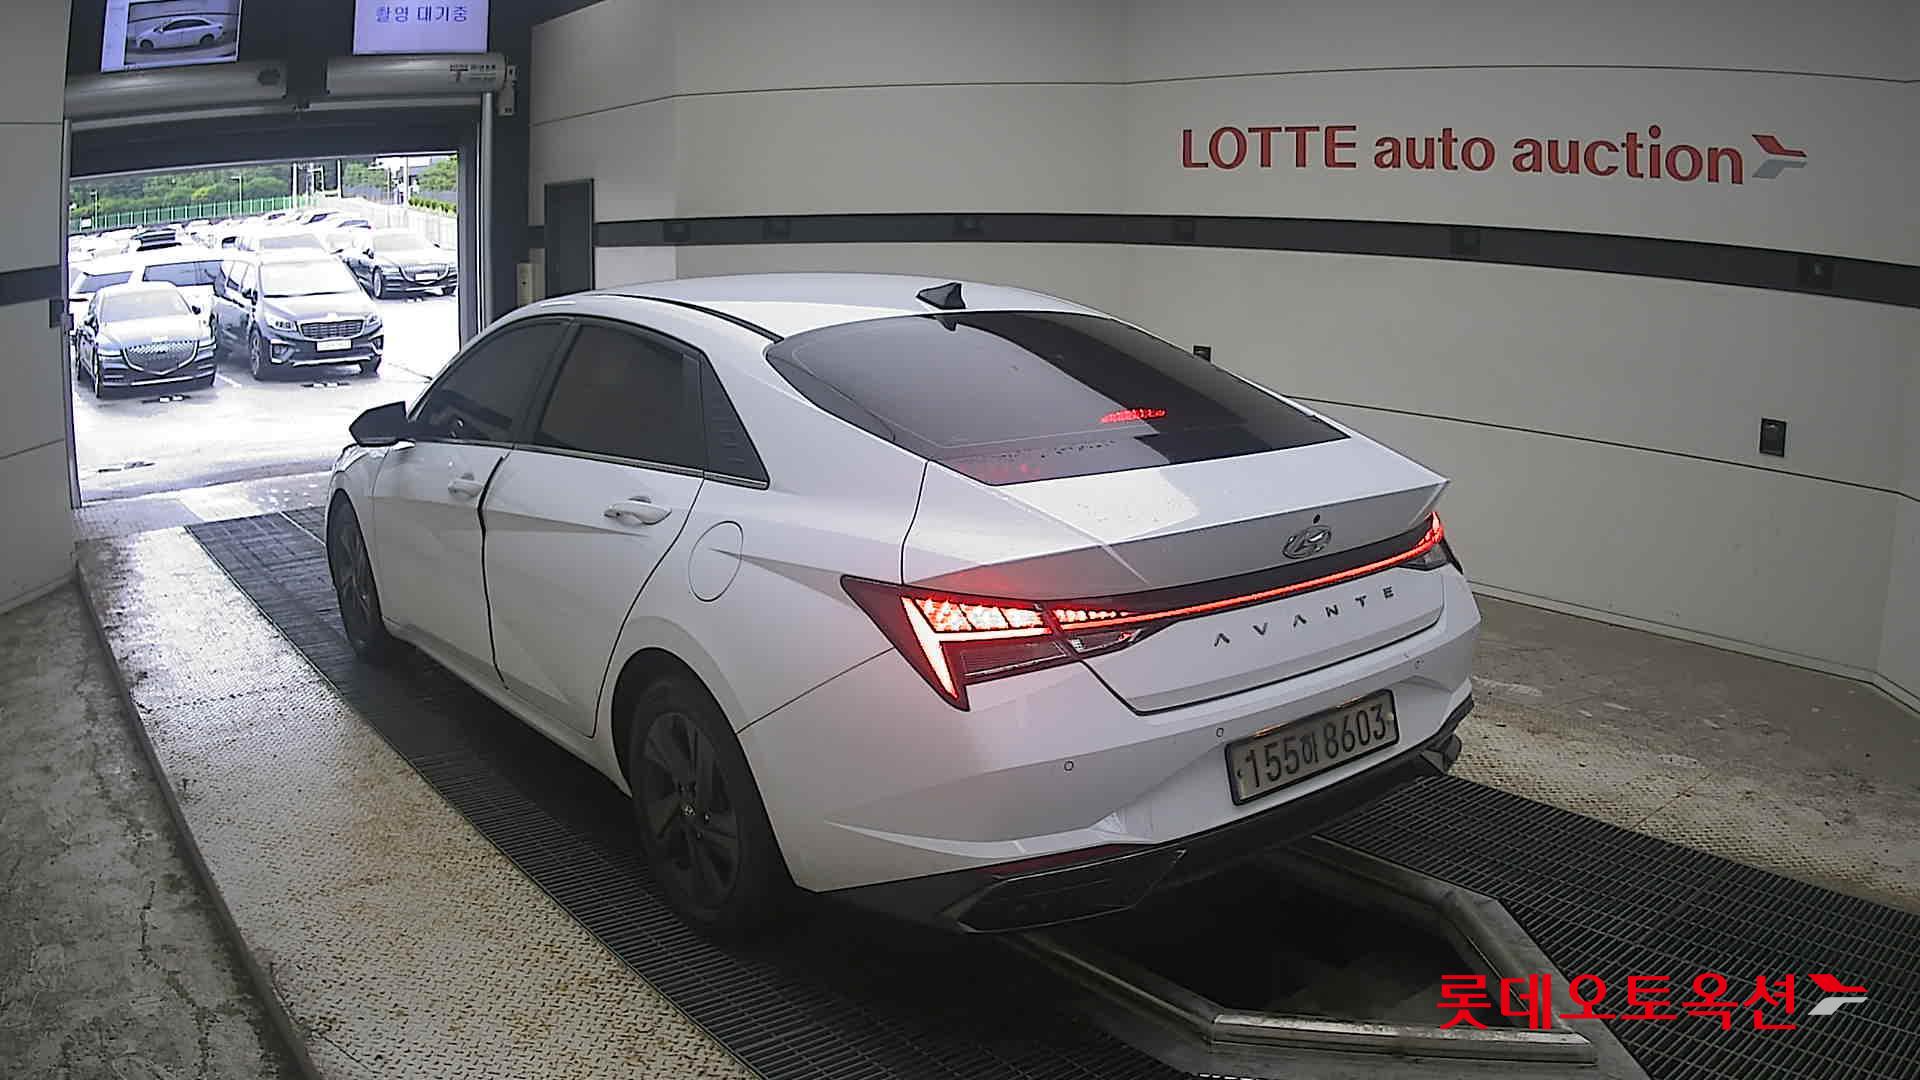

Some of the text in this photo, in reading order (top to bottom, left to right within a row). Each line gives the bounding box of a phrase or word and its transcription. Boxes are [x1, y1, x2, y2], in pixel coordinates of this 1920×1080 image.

[417, 5, 468, 23] 대기중
[1182, 125, 1744, 184] LOTTE auto auction
[1214, 587, 1394, 647] AVANTE
[1323, 703, 1386, 759] 8603
